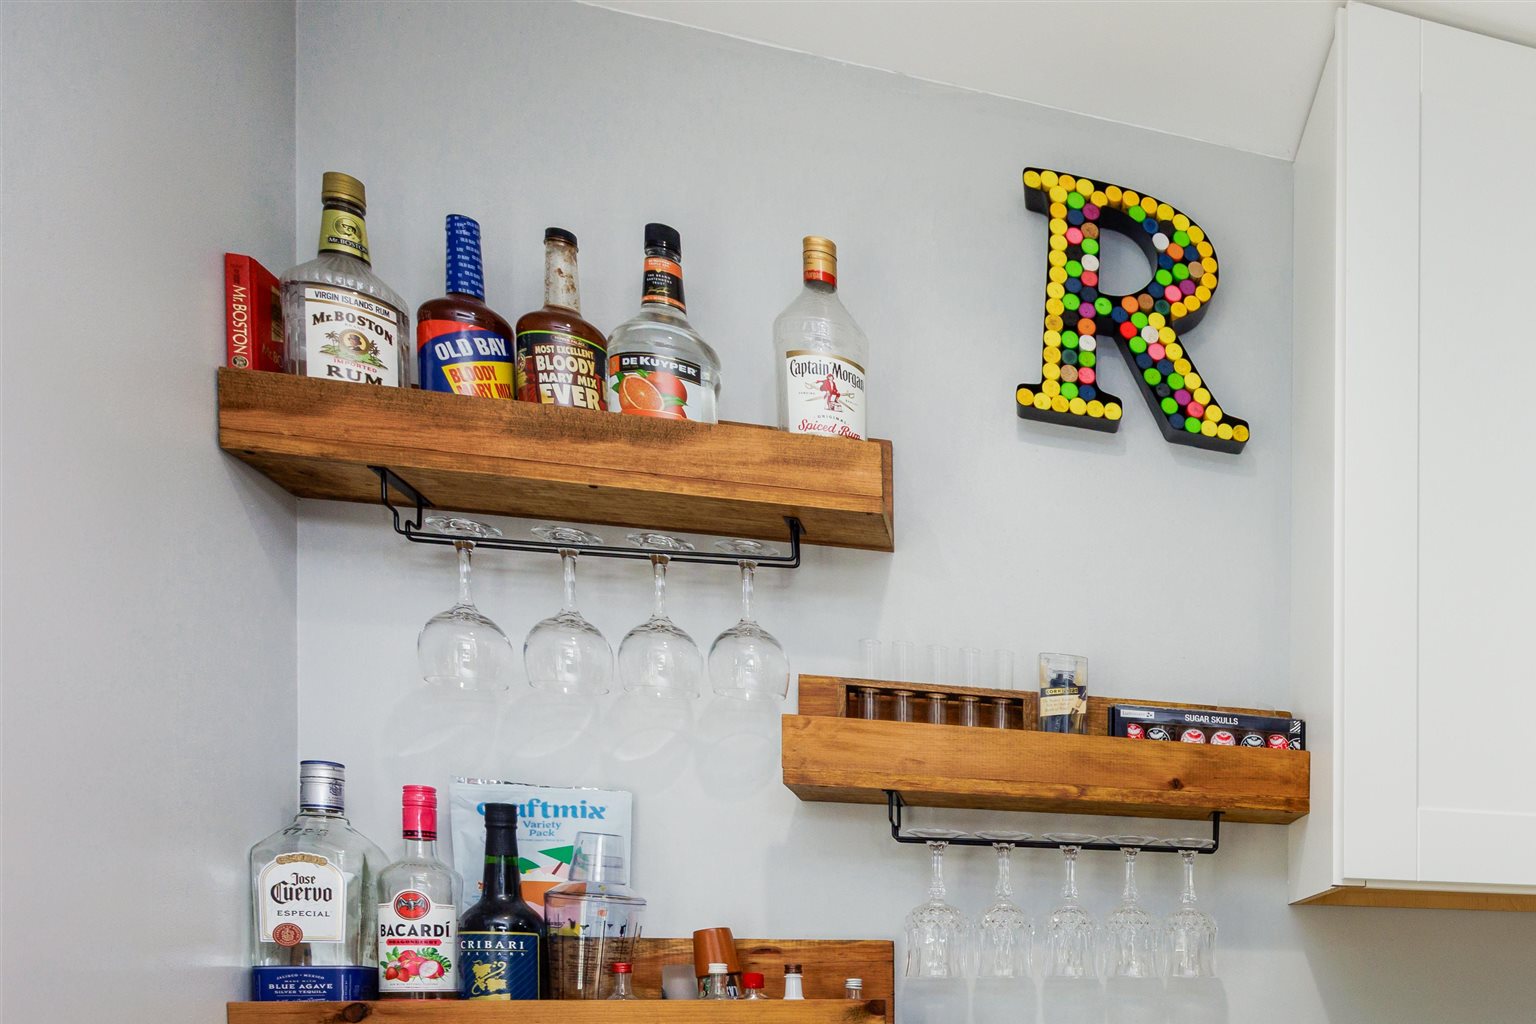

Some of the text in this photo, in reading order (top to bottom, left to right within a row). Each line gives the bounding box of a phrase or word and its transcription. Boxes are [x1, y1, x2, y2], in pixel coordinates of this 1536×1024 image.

[314, 290, 390, 317] VIRGIN ISLANDS RUM
[232, 303, 248, 355] BOSTON
[334, 311, 393, 346] BOSTON
[434, 337, 507, 361] OLD BAY
[534, 344, 594, 359] MOST EXCELLENT
[326, 364, 383, 386] RUM
[333, 358, 378, 373] IMPORTED
[448, 365, 498, 384] BLOODY
[535, 354, 595, 377] BLOODY
[538, 372, 598, 390] MARY MIX
[789, 359, 865, 393] Captain Morgan
[539, 383, 600, 411] EVER
[798, 418, 862, 440] Spiced Rum
[1184, 713, 1239, 726] SUGAR SKULLS
[522, 820, 562, 831] Variety
[528, 829, 555, 837] Pack
[290, 872, 316, 886] Jose
[270, 880, 333, 905] Cuervo
[276, 910, 331, 918] ESPECIAL
[380, 921, 451, 938] BACARDÍ
[460, 940, 525, 950] CRIBARI
